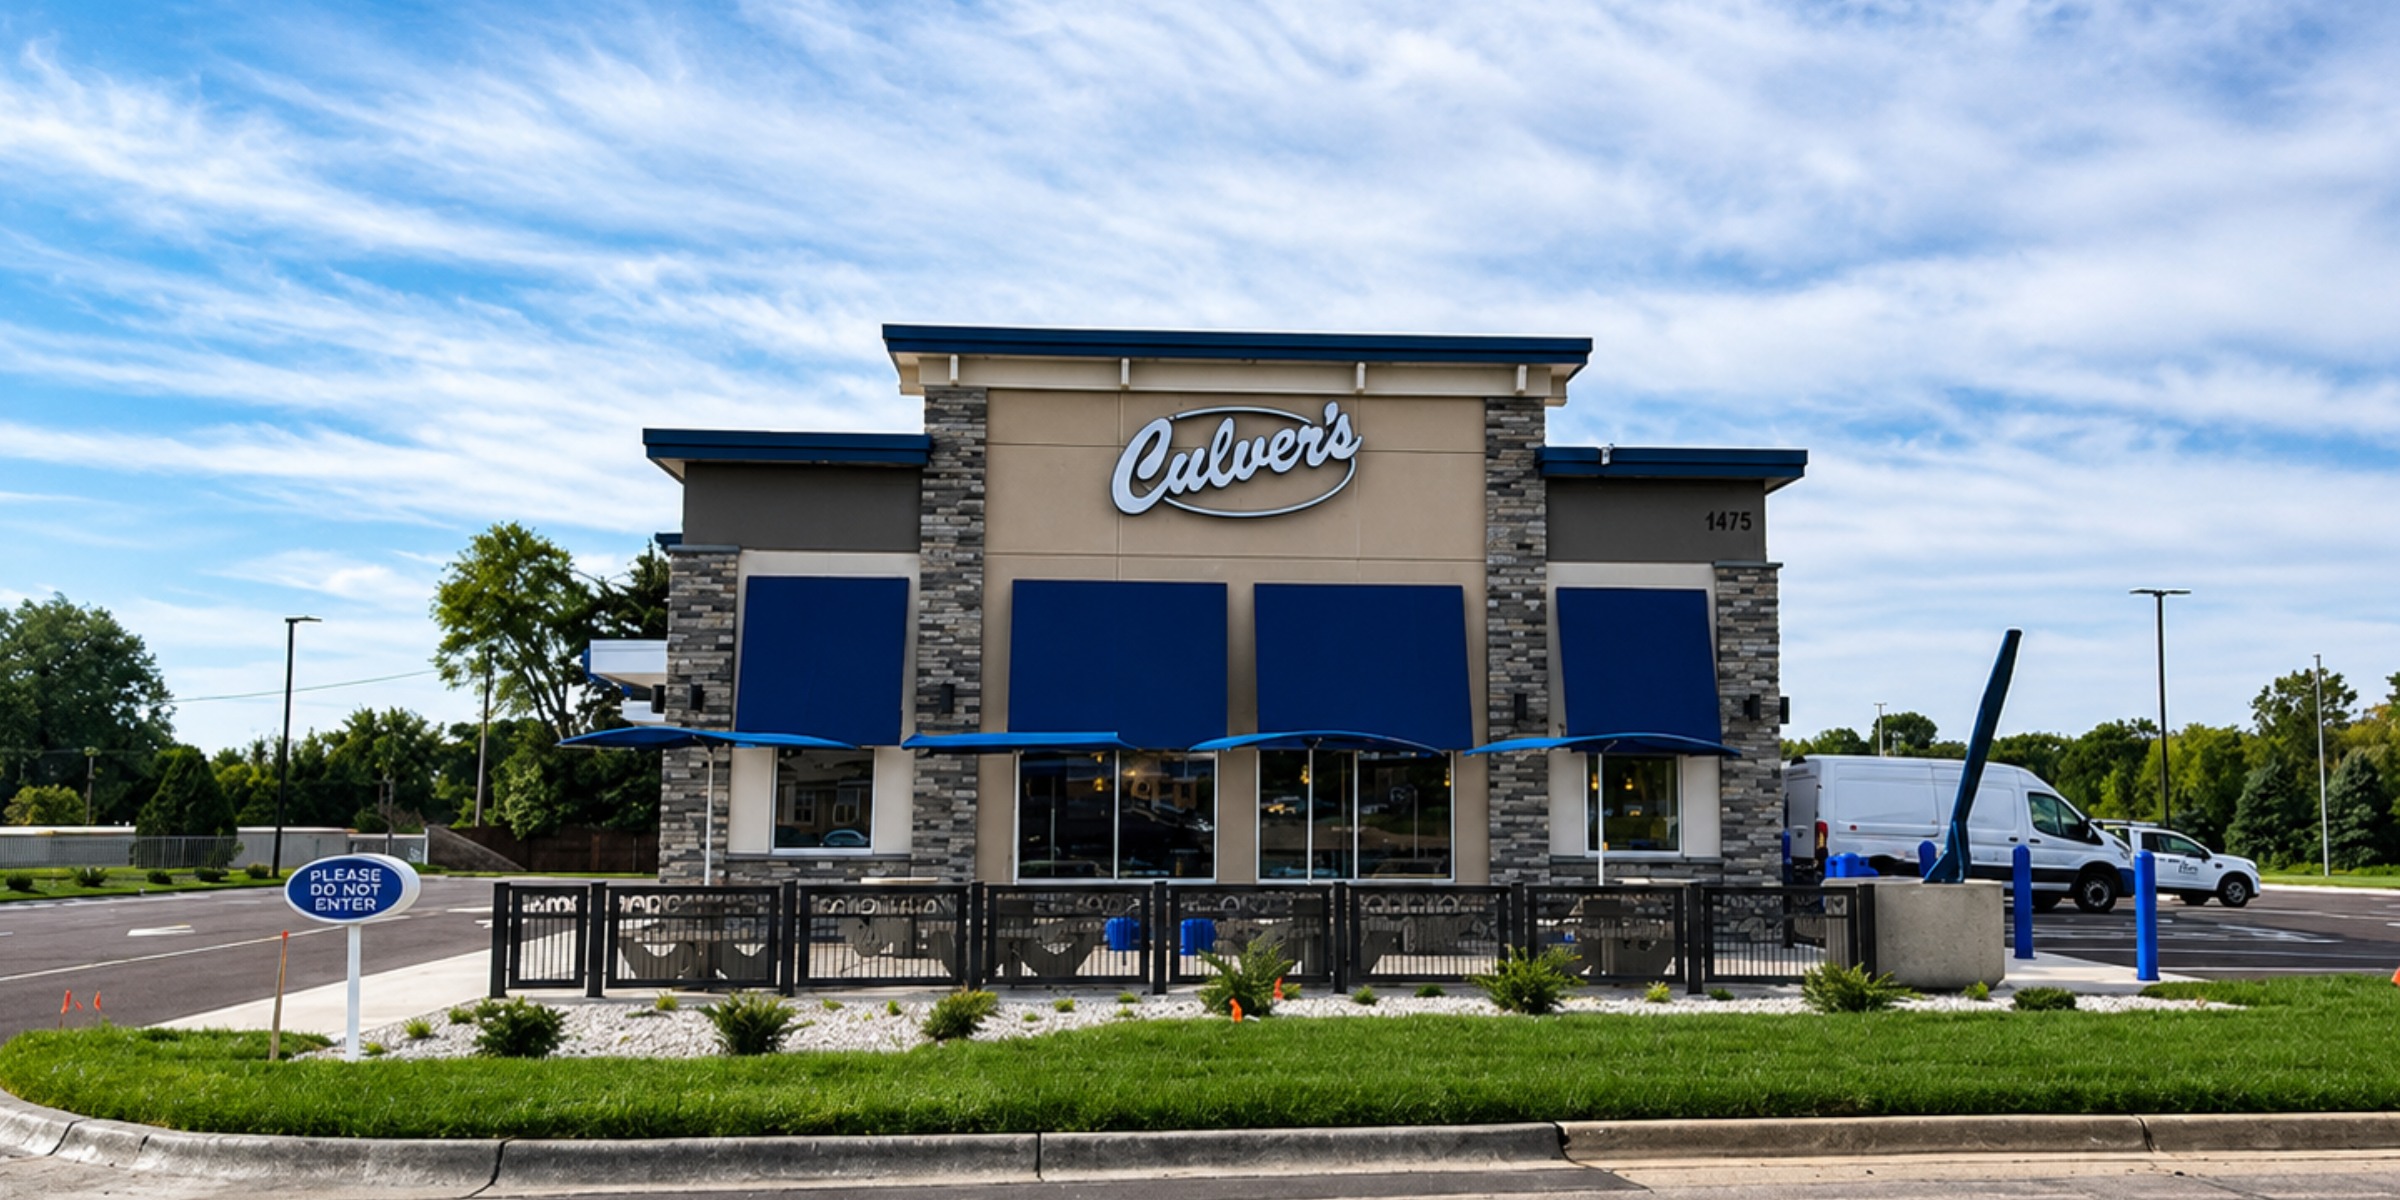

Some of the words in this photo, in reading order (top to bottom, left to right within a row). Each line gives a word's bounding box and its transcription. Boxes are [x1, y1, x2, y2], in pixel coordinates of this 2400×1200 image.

[1111, 401, 1363, 515] Culver's
[1705, 511, 1752, 531] 1475
[310, 868, 382, 882] PLEASE
[310, 883, 337, 896] DO
[343, 883, 381, 896] NOT
[315, 898, 377, 911] ENTER
